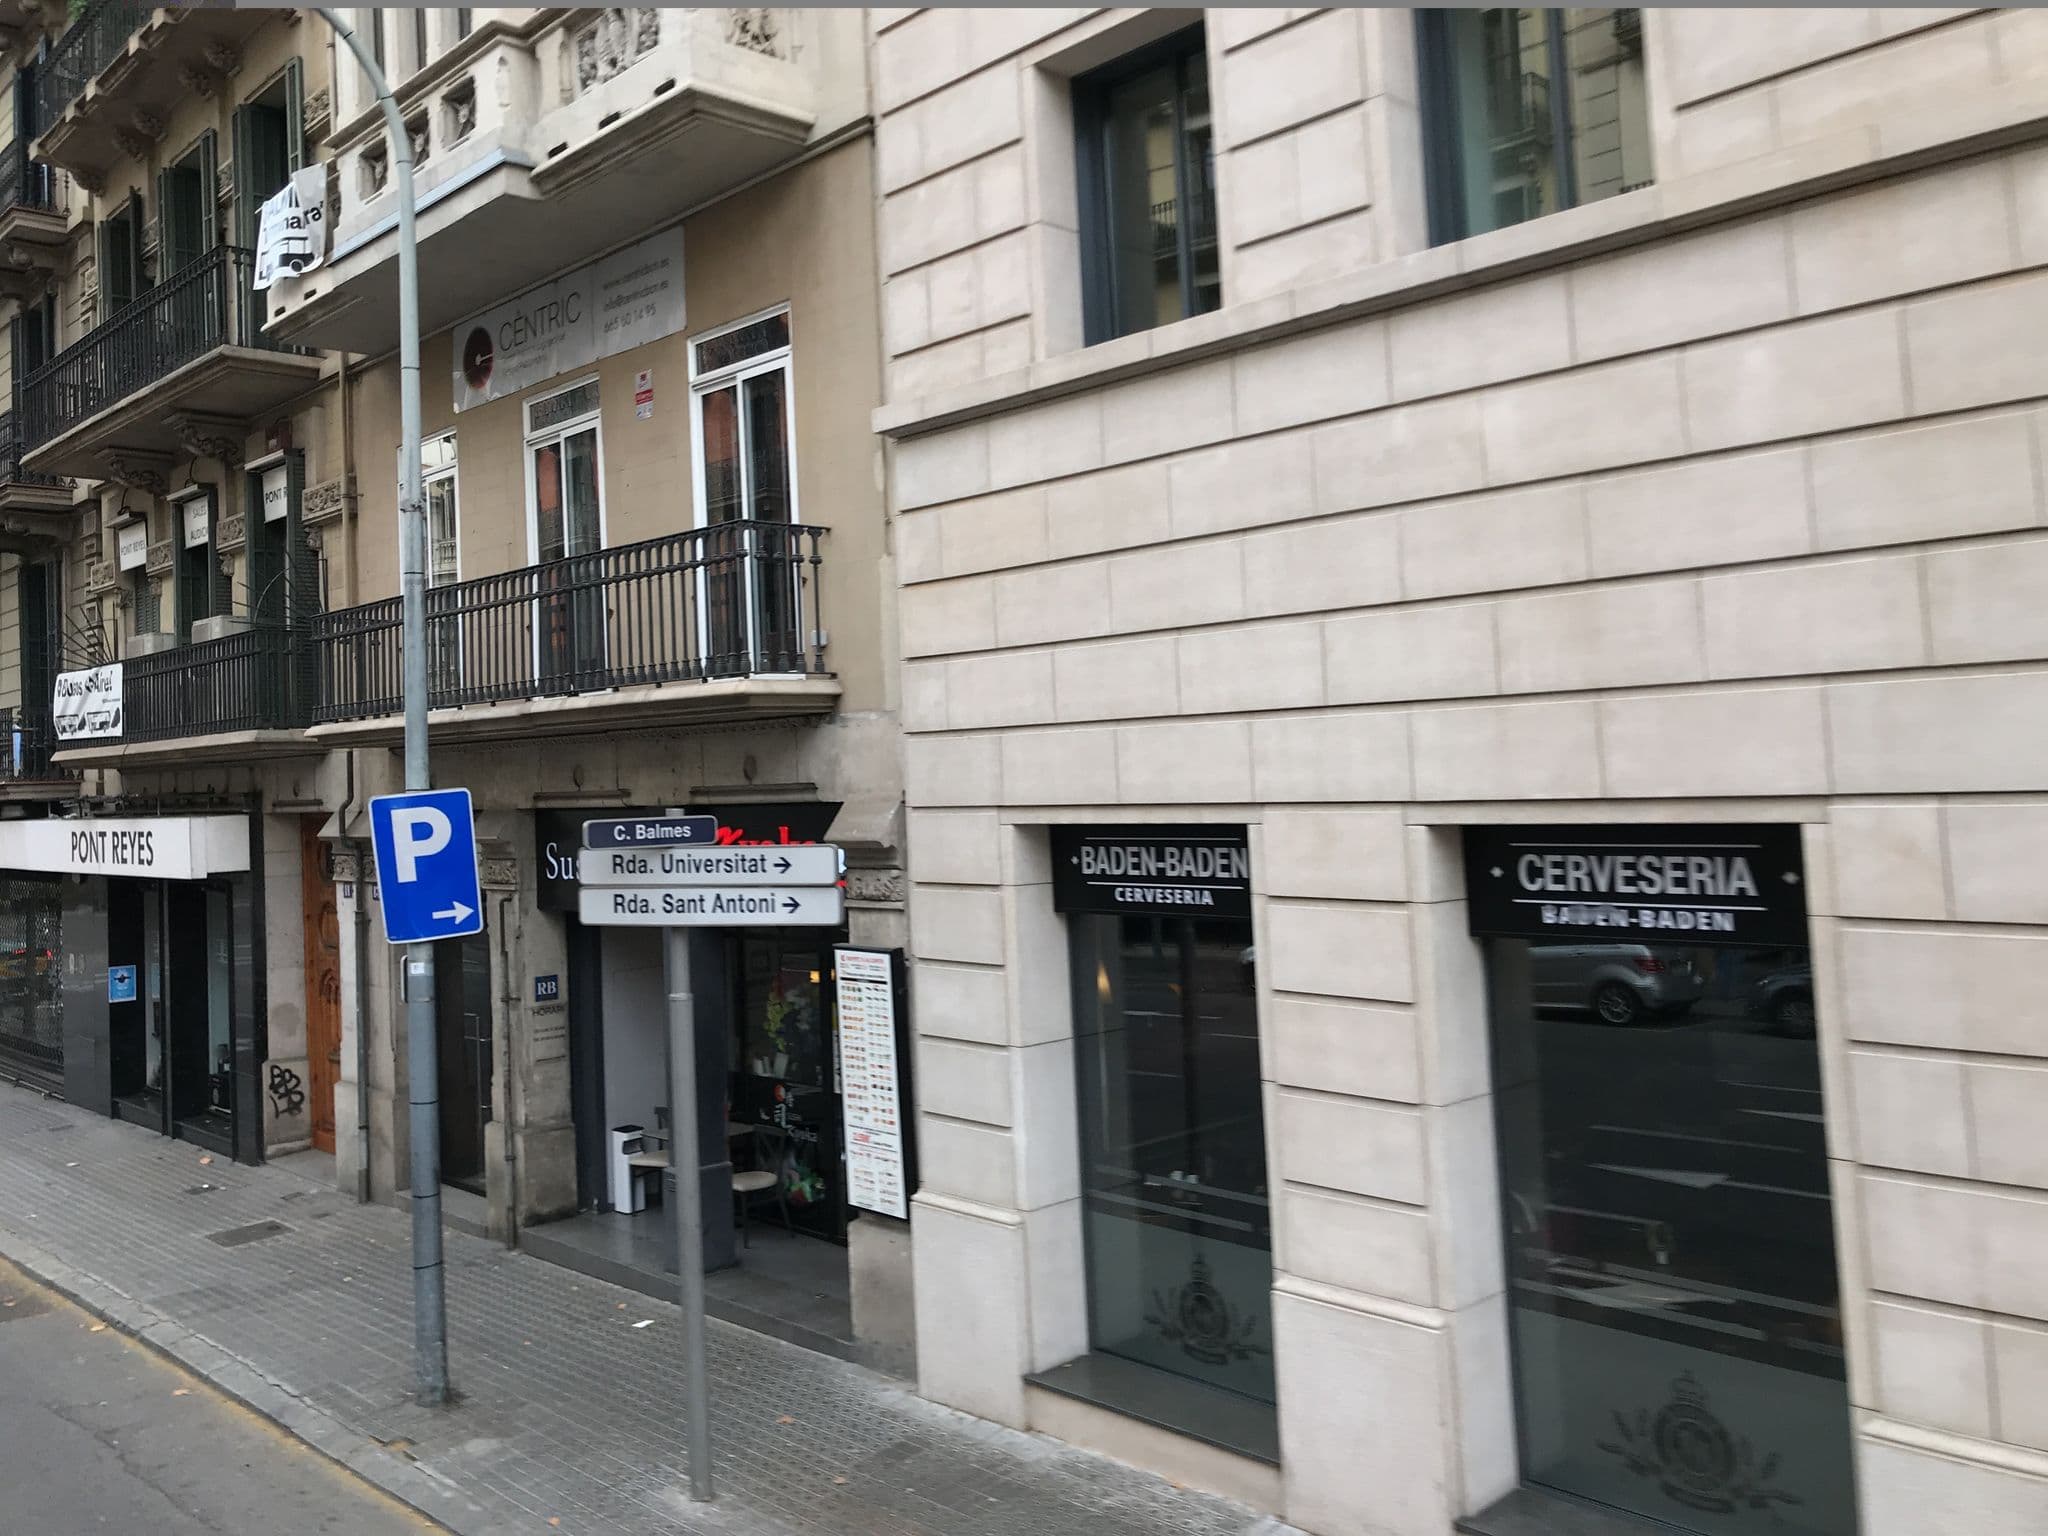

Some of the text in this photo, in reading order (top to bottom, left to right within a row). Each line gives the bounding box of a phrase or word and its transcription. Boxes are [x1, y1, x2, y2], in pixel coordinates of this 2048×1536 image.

[265, 488, 282, 504] PONT
[613, 824, 692, 841] C. Balmes
[71, 831, 154, 866] PONT REYES
[391, 806, 452, 883] P
[612, 853, 767, 874] Rda. Universitat
[1080, 846, 1249, 878] BADEN-BADEN
[1517, 853, 1760, 896] CERVESERIA
[613, 893, 777, 914] Rda. Sant Antoni
[1114, 887, 1215, 905] CERVESERIA
[537, 981, 557, 996] RB
